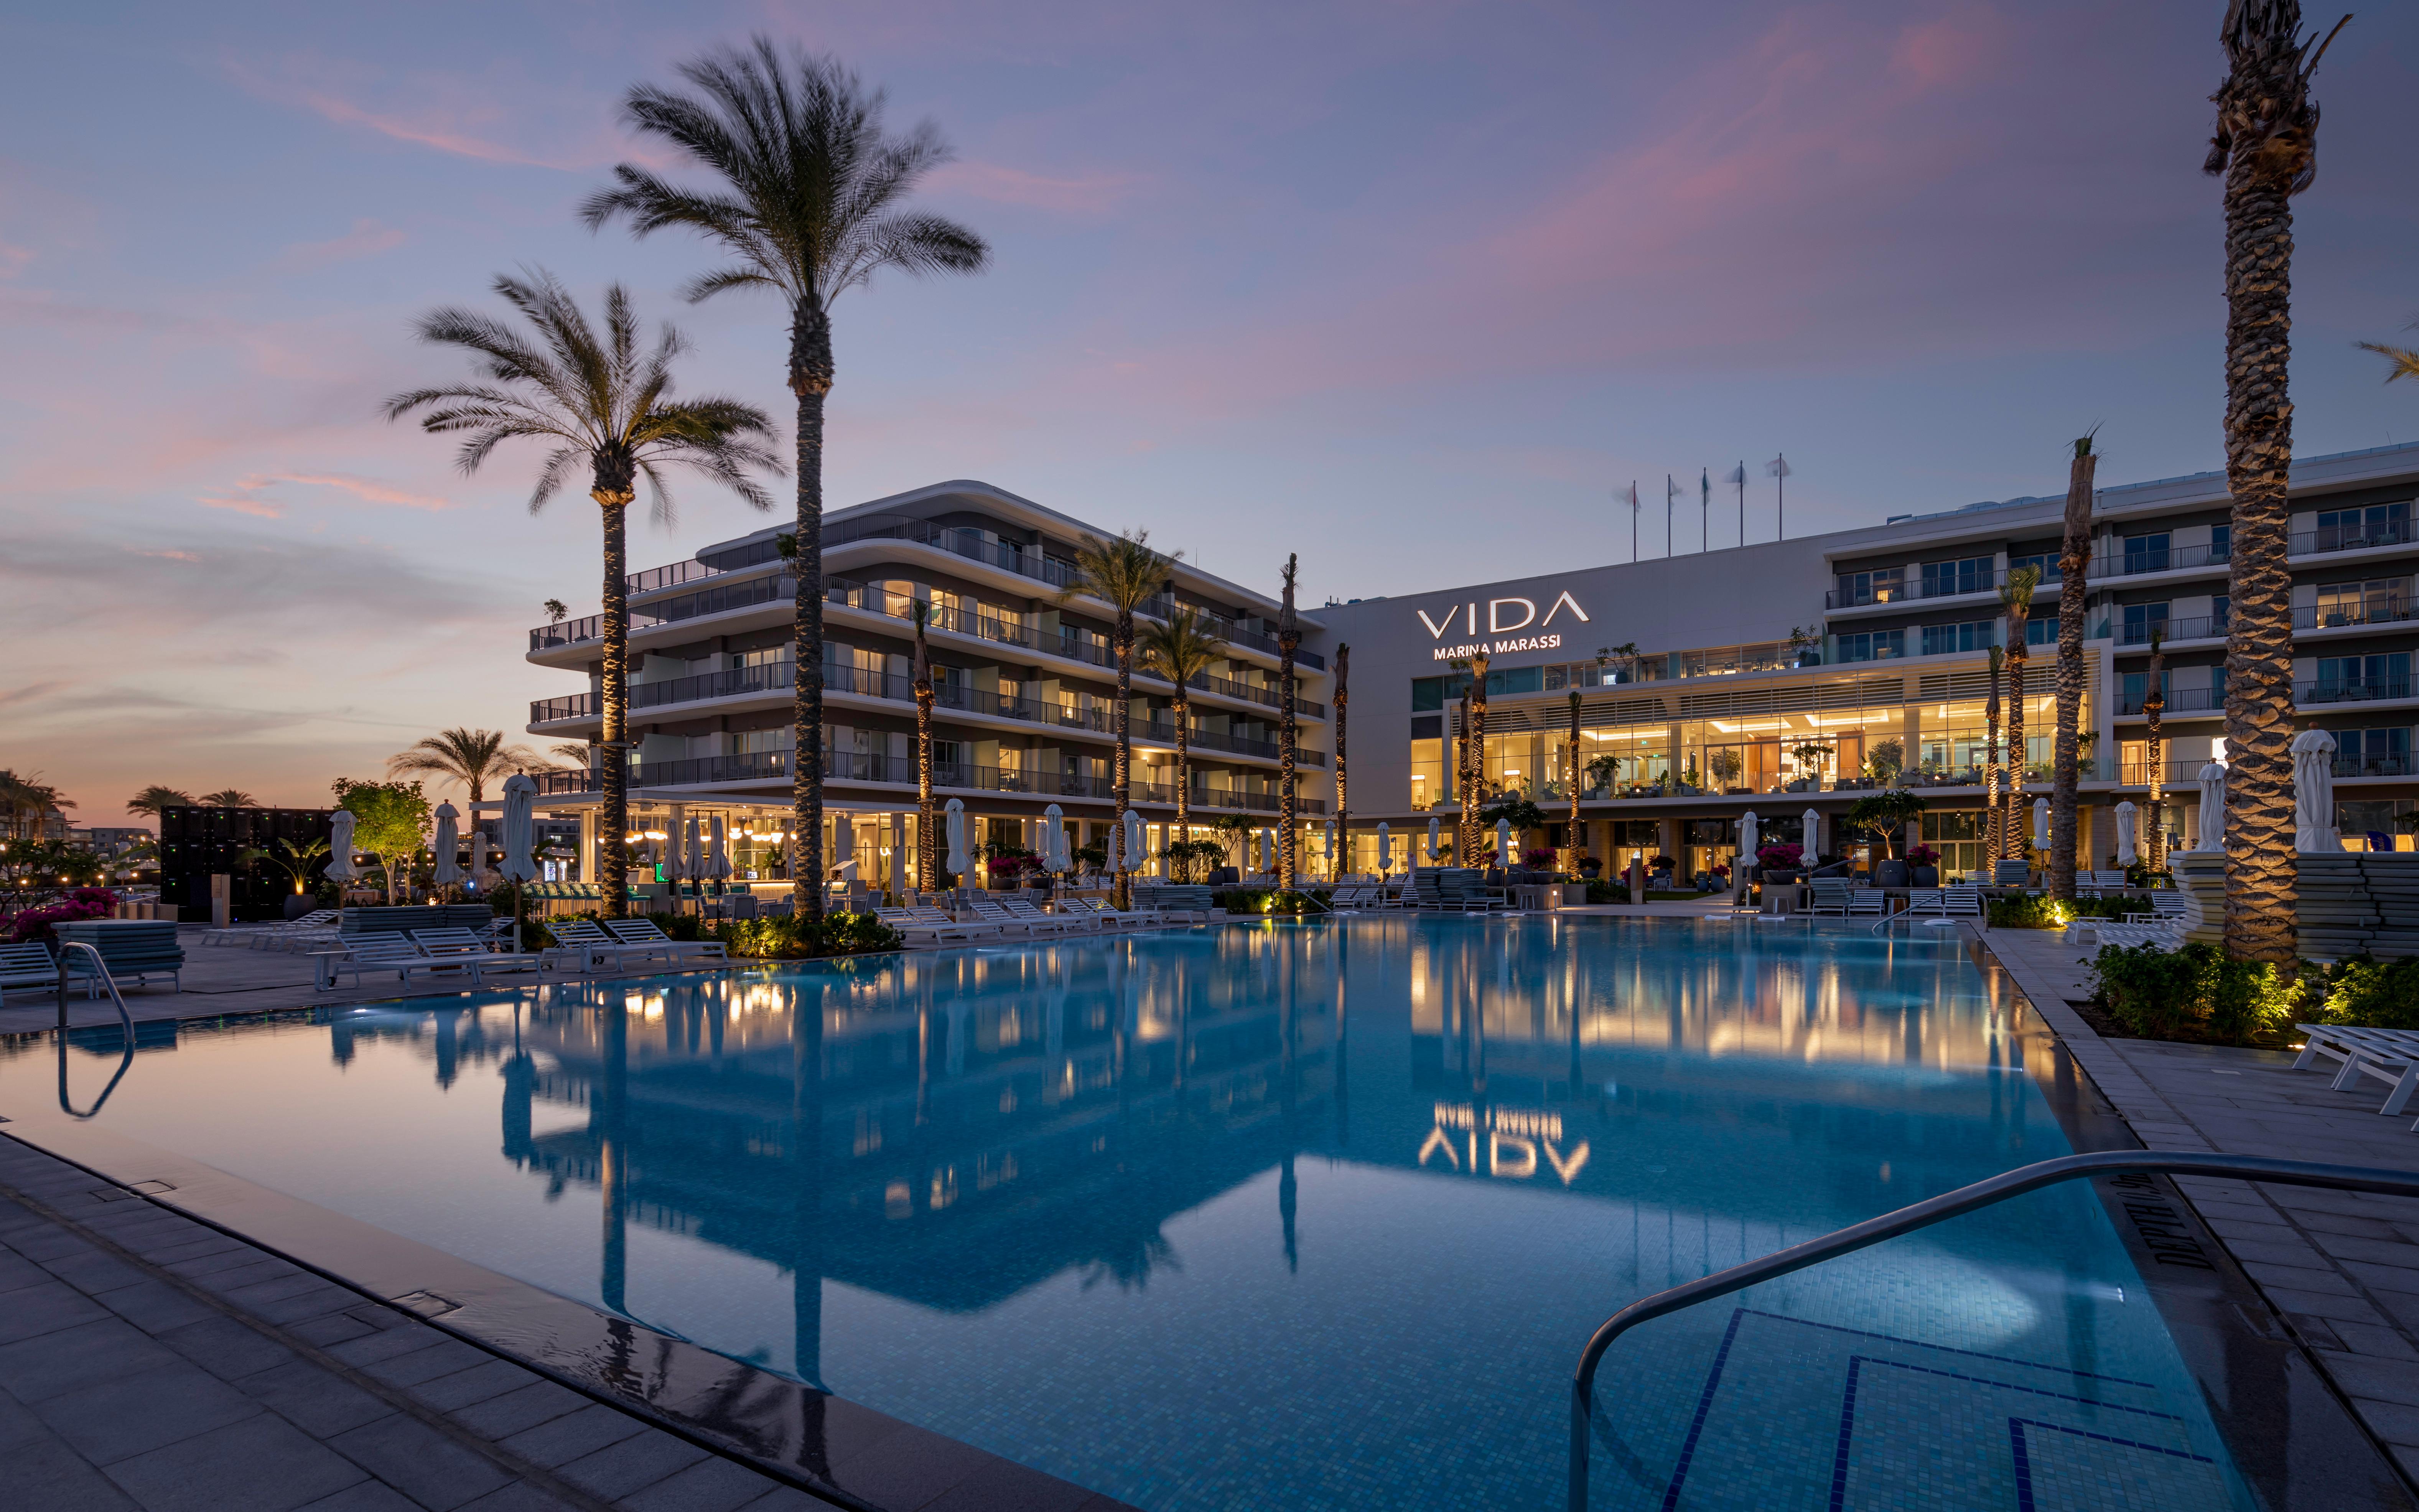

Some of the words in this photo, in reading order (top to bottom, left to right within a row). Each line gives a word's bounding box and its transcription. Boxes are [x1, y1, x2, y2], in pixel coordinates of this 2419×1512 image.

[1417, 590, 1589, 639] VIDA
[1434, 643, 1491, 660] MARINA
[1495, 634, 1560, 653] MARASSI
[2122, 1201, 2217, 1272] DEPTH
